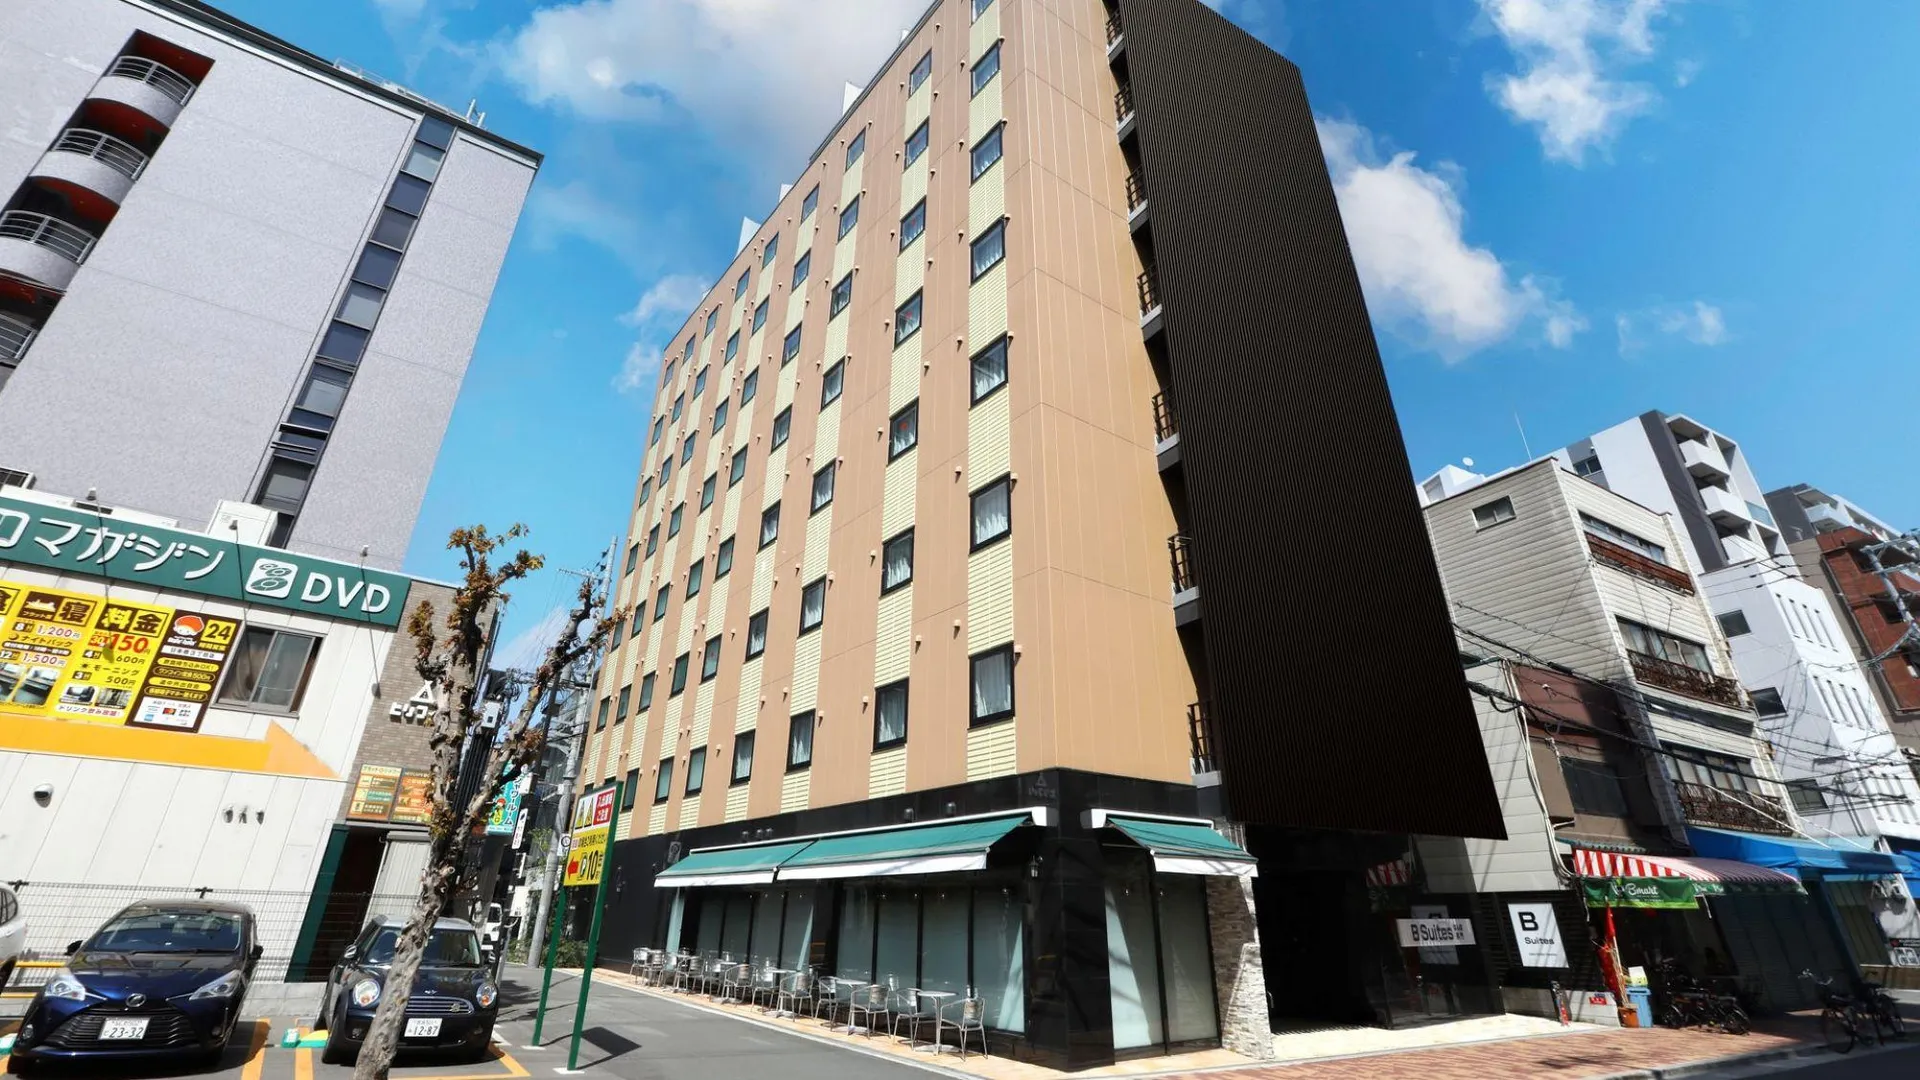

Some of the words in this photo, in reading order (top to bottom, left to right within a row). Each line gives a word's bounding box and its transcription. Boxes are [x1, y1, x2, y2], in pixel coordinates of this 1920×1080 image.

[301, 572, 391, 613] DVD
[101, 607, 162, 634] 料金
[205, 623, 232, 640] 24
[1518, 911, 1539, 931] B
[1411, 924, 1419, 941] B
[1421, 924, 1454, 941] Suites
[1525, 937, 1555, 945] Suites
[109, 1027, 144, 1038] 23-32
